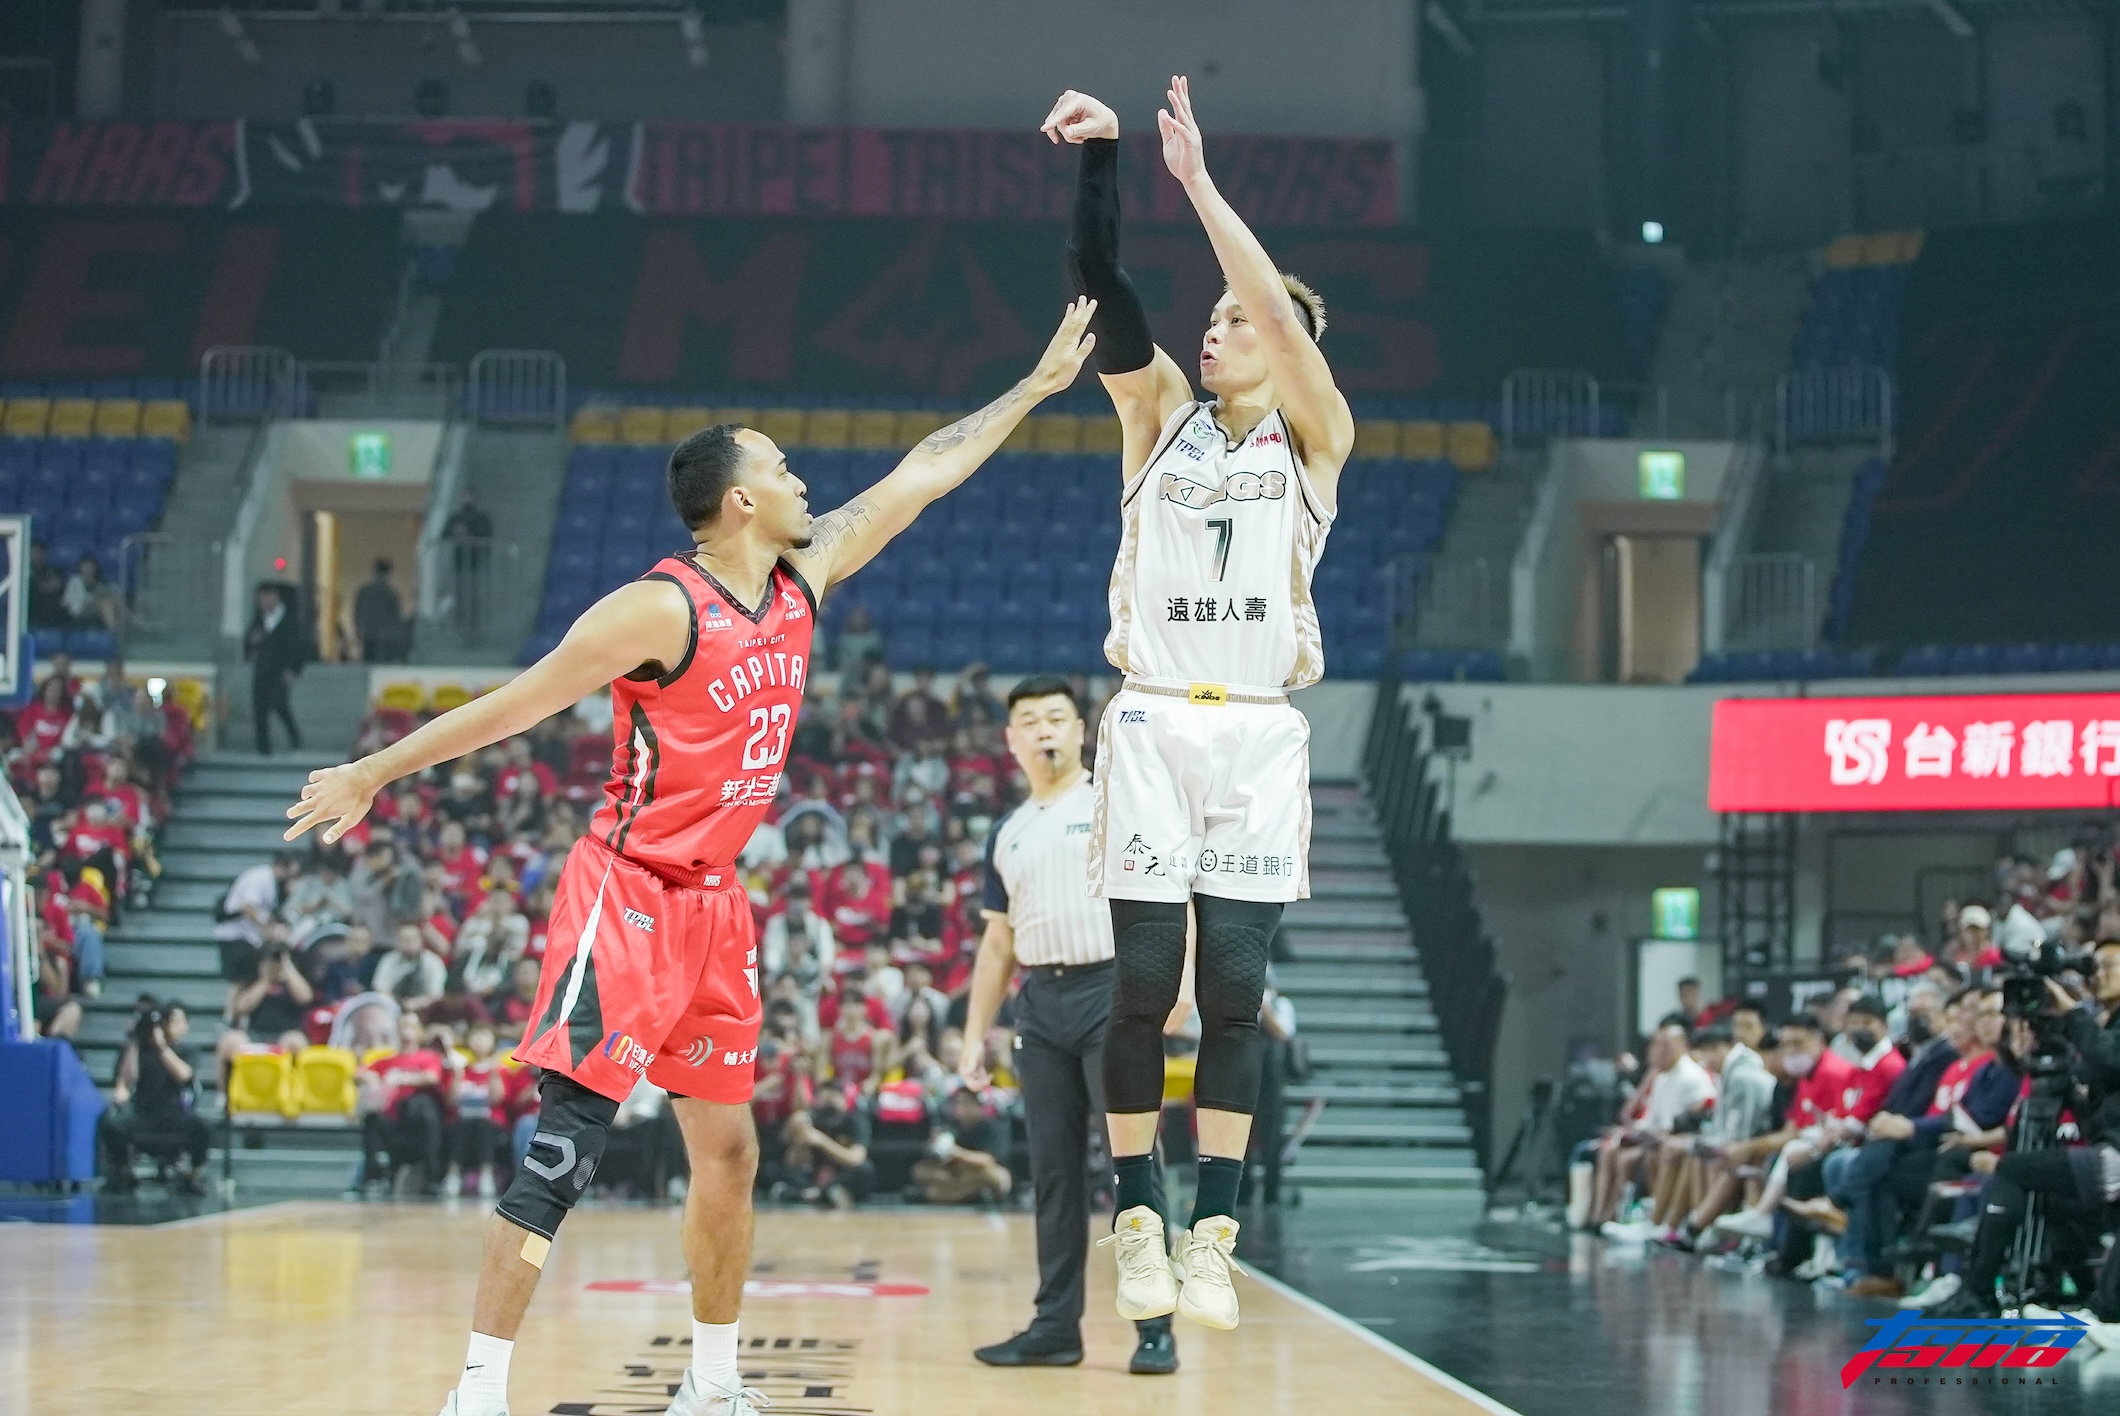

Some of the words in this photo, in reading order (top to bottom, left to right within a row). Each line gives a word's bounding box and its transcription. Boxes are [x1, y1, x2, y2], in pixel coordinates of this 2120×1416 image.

[30, 120, 236, 204] MARS
[645, 126, 855, 214] TAIPEI
[881, 128, 1155, 218] TAISHN
[1205, 518, 1233, 582] 7
[1167, 597, 1267, 622] 遠雄人壽
[738, 637, 768, 649] TAIPEI
[770, 633, 786, 645] CITY
[742, 703, 792, 771] 23
[1903, 719, 2120, 779] 台新銀行
[1220, 854, 1294, 877] 王道銀行
